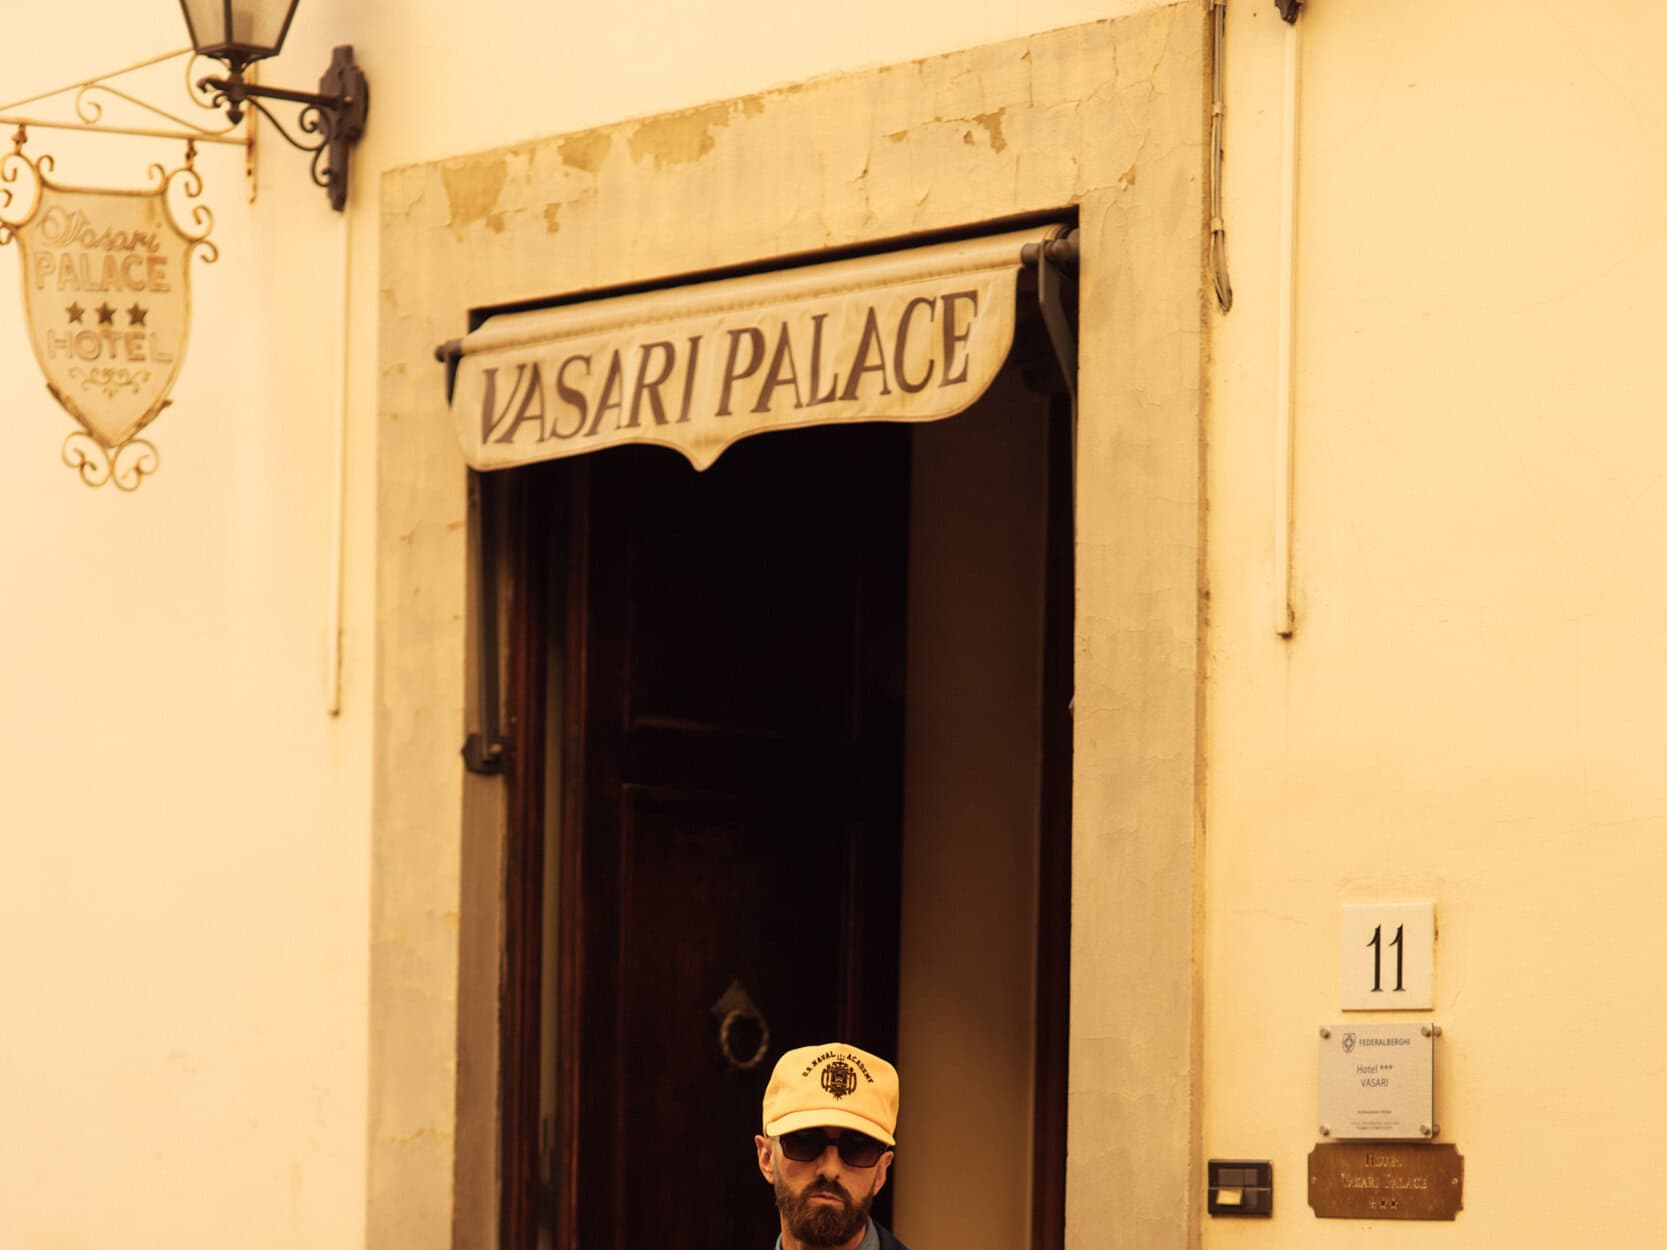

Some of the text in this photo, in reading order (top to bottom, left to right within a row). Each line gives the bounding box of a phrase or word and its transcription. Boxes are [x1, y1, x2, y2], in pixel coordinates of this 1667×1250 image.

[35, 205, 162, 253] Vasari
[33, 251, 171, 292] PALACE
[47, 328, 173, 363] HOTEL
[481, 289, 979, 446] VASARI PALACE
[1366, 923, 1407, 992] 11
[811, 1050, 836, 1067] NAVAL
[846, 1053, 874, 1083] ACADEMY
[1356, 1064, 1378, 1075] Hotel
[1360, 1078, 1389, 1088] VASARI
